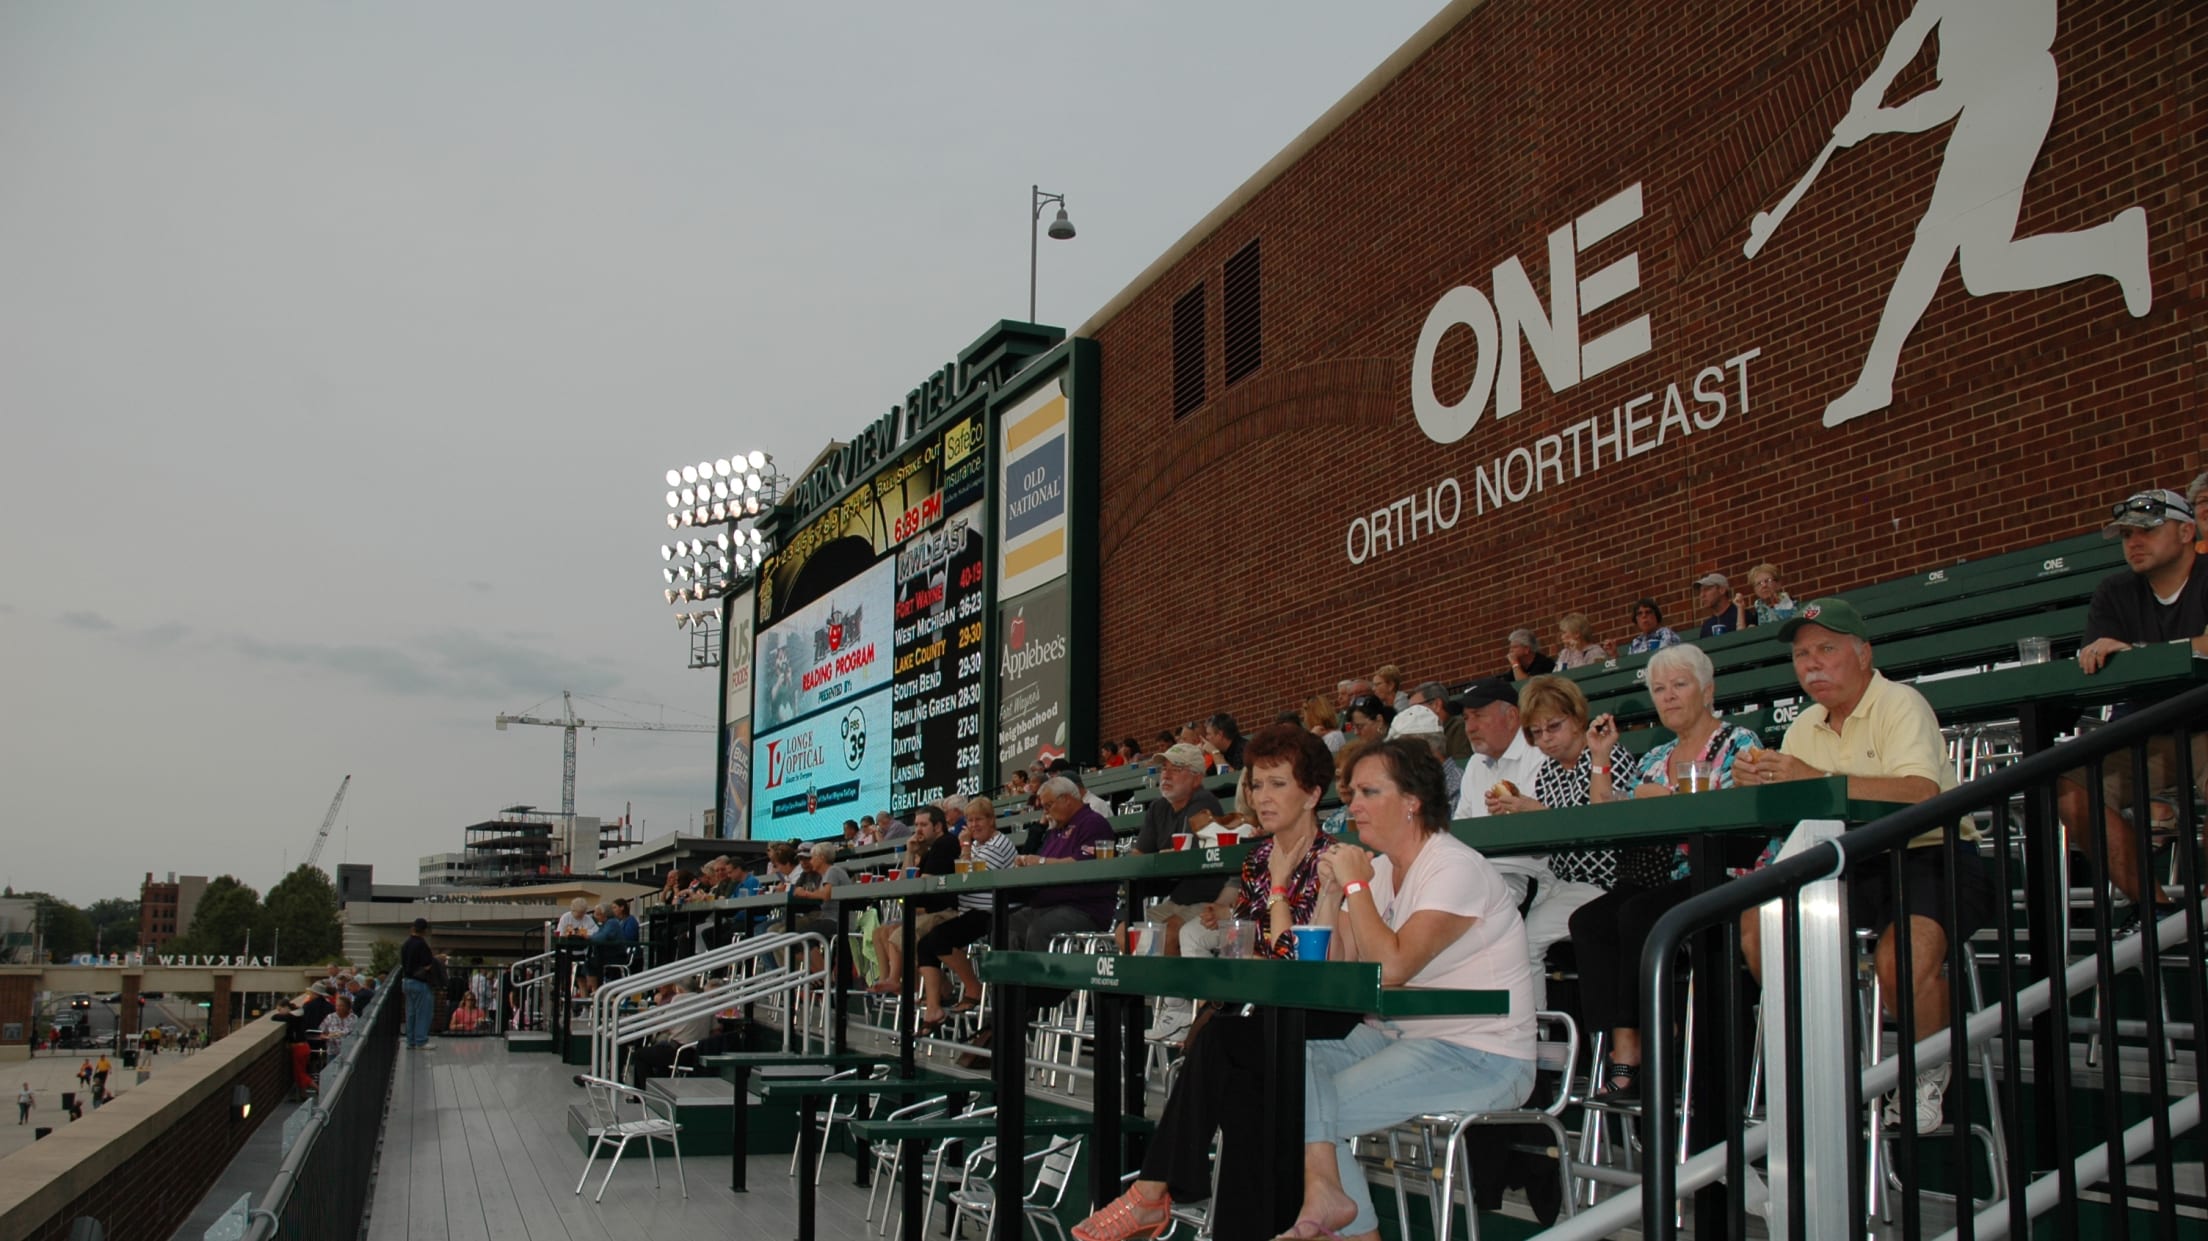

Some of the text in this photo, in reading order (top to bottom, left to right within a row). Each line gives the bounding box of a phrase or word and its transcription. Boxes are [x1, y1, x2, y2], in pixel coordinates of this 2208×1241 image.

[1411, 181, 1652, 445] ONE
[794, 358, 980, 522] PARKVIEW FIELD
[947, 423, 983, 460] Safeco
[1346, 347, 1763, 565] ORTHO NORTHEAST
[1023, 465, 1046, 492] OLD
[922, 490, 942, 528] PM
[1009, 479, 1061, 521] NATIONAL
[2043, 557, 2064, 571] ONE
[895, 560, 983, 619] FORT WAYNE 40-19
[895, 624, 916, 648] WEST
[917, 606, 956, 638] MICHIGAN
[959, 591, 982, 619] 36-23
[802, 641, 875, 692] READING PROGRAM
[894, 622, 982, 674] LAKE COUNTY 29-30
[1000, 634, 1066, 681] Applebee's
[732, 666, 749, 689] FOODS
[894, 651, 981, 702] SOUTH BEND 29-30
[893, 682, 980, 729] BOWLING GREEN 28-30
[999, 701, 1058, 746] Neighborhood
[1773, 705, 1799, 724] ONE
[786, 731, 814, 755] LONGE
[849, 731, 866, 762] 39
[893, 713, 979, 756] DAYTON 27-31
[999, 742, 1016, 764] Grill
[1024, 733, 1039, 748] Bar
[786, 745, 824, 774] OPTICAL
[892, 744, 980, 784] LANSING 26-32
[891, 791, 917, 811] GREAT
[917, 785, 944, 806] LAKES
[1206, 848, 1221, 862] ONE
[428, 894, 468, 905] GRAND
[1096, 956, 1115, 977] ONE
